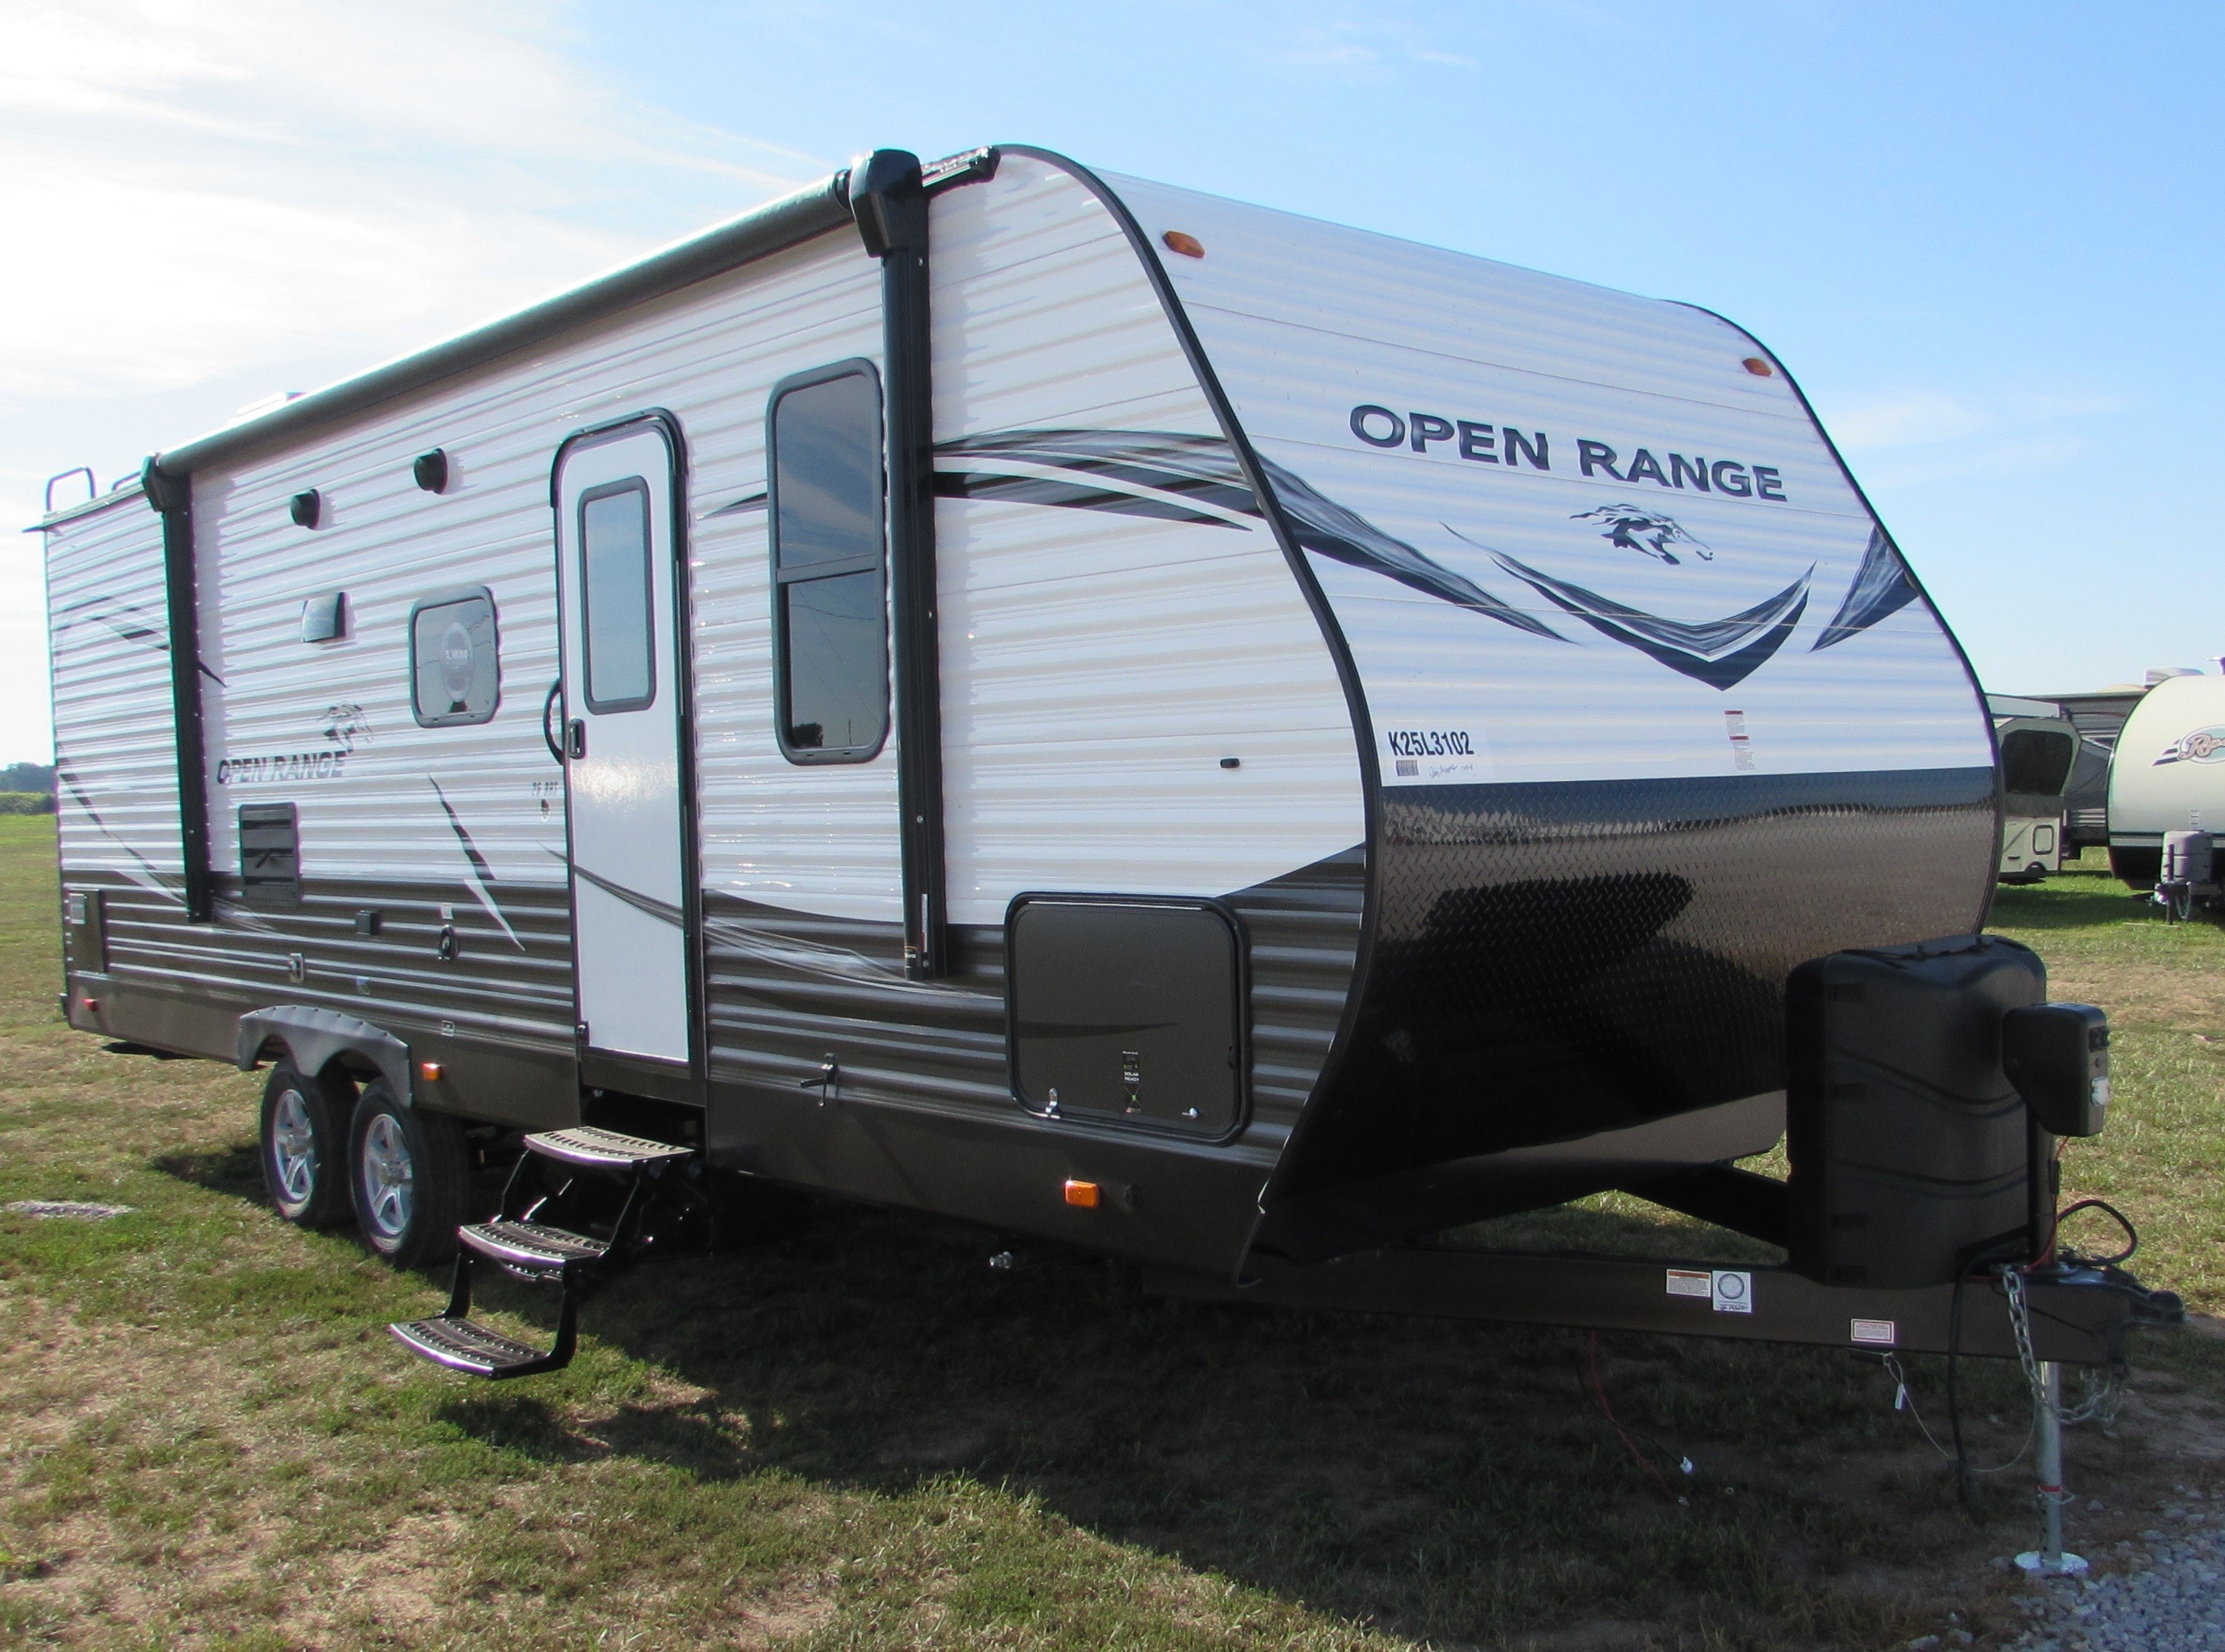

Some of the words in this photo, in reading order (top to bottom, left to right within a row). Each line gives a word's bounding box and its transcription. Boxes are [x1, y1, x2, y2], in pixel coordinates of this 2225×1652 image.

[1349, 405, 1550, 471] OPEN
[1577, 439, 1787, 501] RANGE
[1387, 731, 1475, 757] K25L3102
[217, 757, 268, 784] OPEN
[273, 750, 348, 783] RANGE
